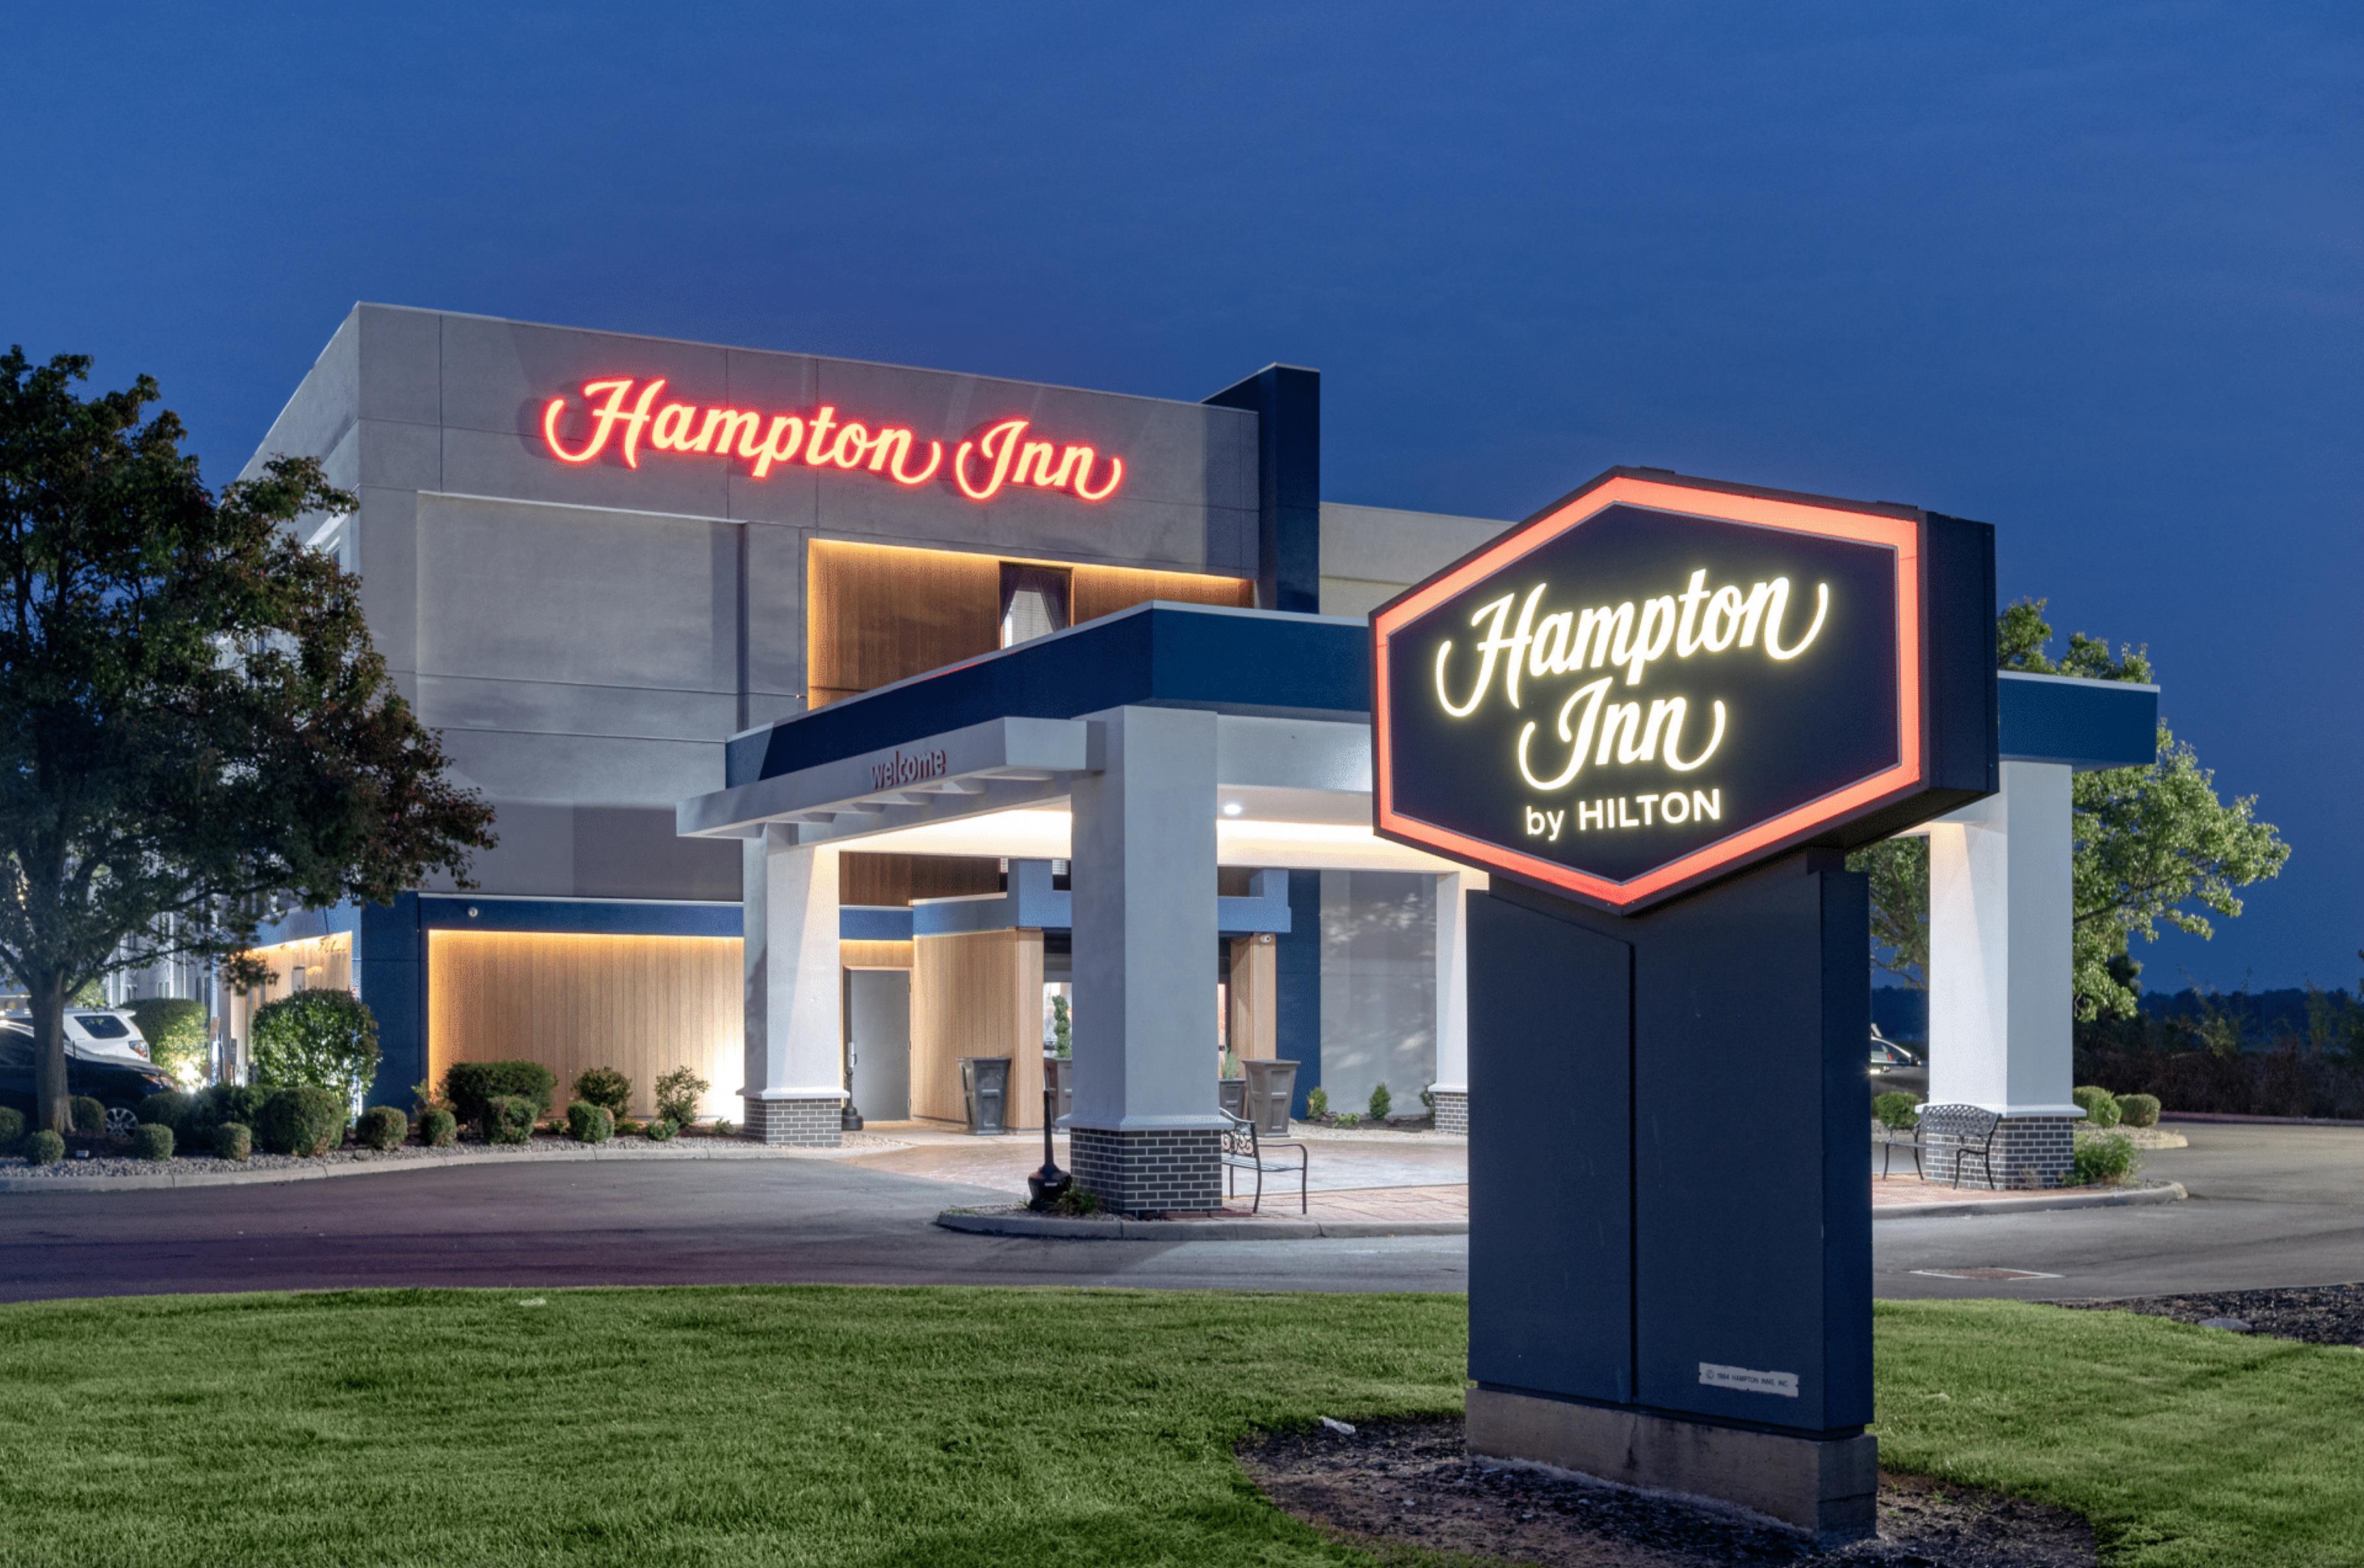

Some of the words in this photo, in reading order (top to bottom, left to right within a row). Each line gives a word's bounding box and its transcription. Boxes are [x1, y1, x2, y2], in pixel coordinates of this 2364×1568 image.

[544, 378, 942, 485] Hampton
[955, 419, 1123, 500] Inn
[1434, 567, 1829, 718] Hampton
[872, 749, 946, 790] welcome
[1517, 675, 1727, 791] Inn
[1525, 804, 1565, 842] by
[1578, 788, 1721, 831] HILTON
[1732, 1374, 1758, 1383] HAMPTON
